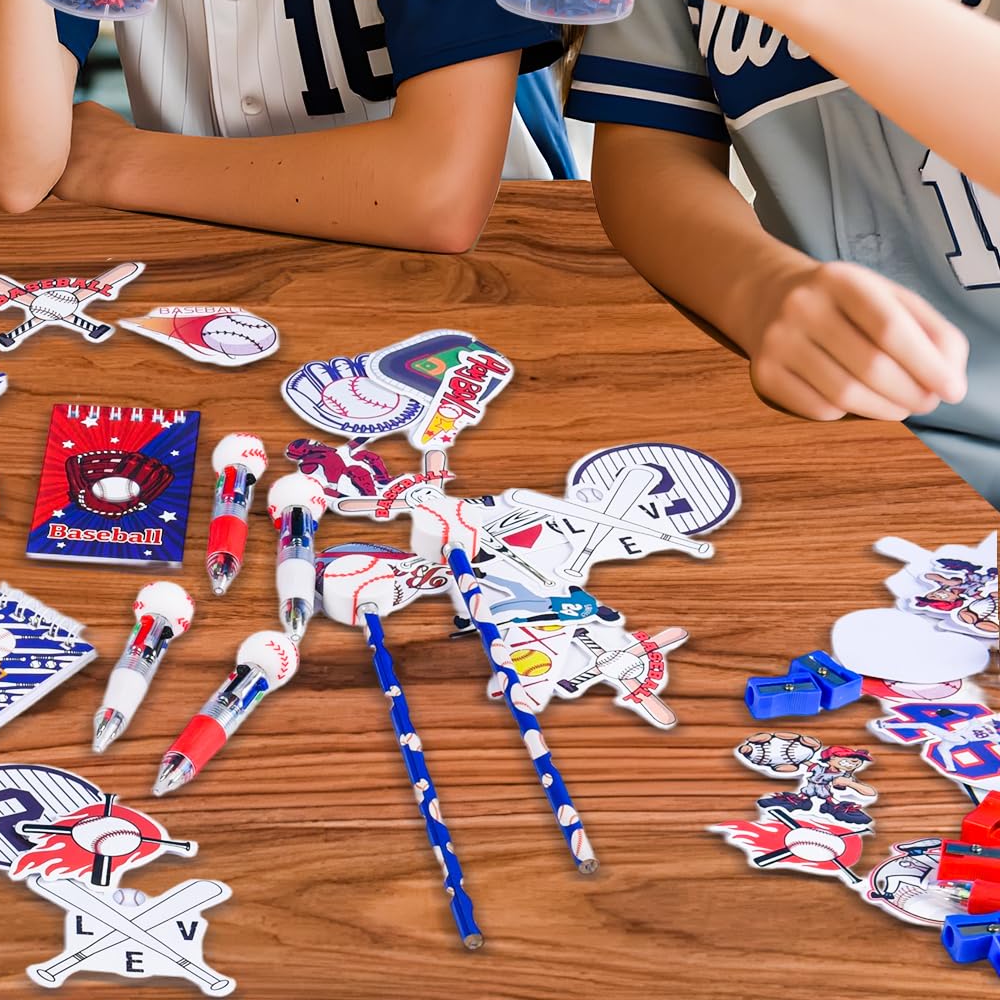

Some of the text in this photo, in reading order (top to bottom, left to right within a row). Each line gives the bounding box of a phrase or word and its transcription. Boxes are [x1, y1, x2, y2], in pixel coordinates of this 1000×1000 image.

[375, 470, 455, 518] BASEBALL
[47, 523, 163, 546] Baseball
[622, 631, 665, 704] BASEBALL
